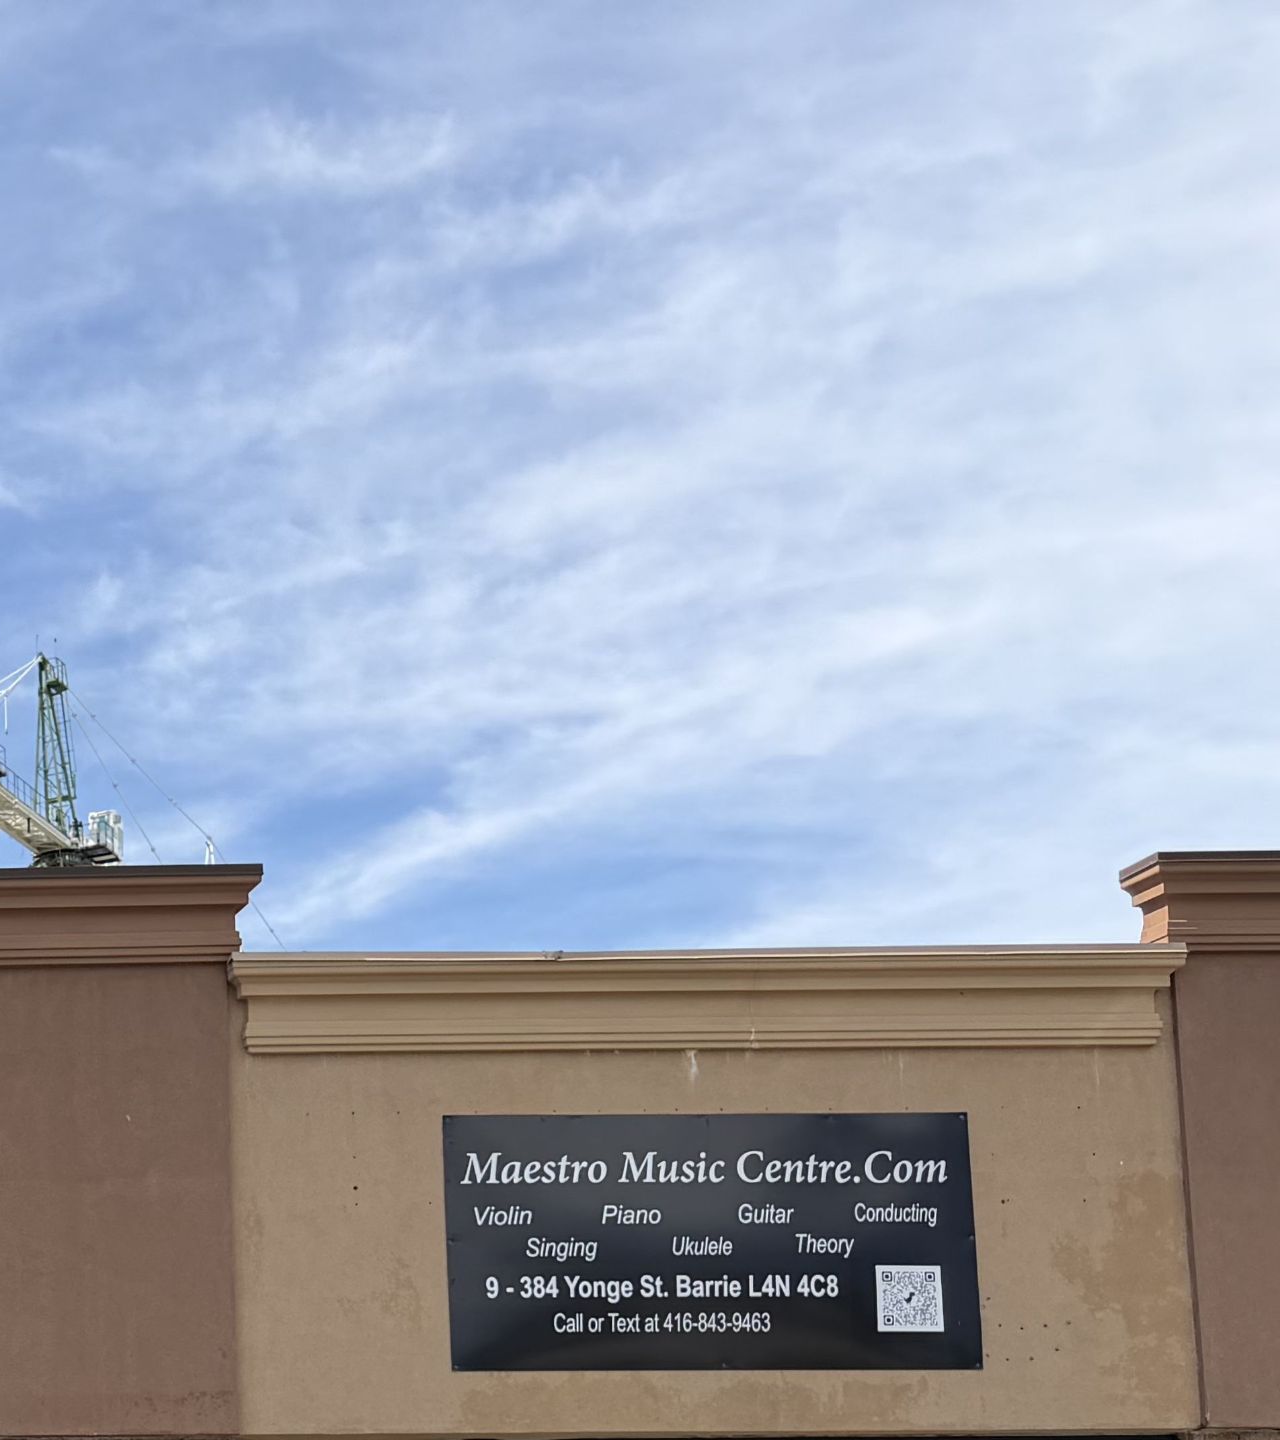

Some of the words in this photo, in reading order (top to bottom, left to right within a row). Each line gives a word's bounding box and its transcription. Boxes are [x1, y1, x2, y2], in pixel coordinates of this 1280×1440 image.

[460, 1151, 608, 1186] Maestro
[617, 1150, 725, 1185] Music
[735, 1149, 948, 1185] Centre.Com
[472, 1205, 533, 1227] Violin
[601, 1204, 662, 1226] Piano
[737, 1203, 794, 1225] Guitar
[853, 1202, 938, 1227] Conducting
[525, 1237, 598, 1262] Singing
[671, 1235, 733, 1257] Ukulele
[795, 1233, 854, 1258] Theory
[485, 1276, 499, 1299] 9
[519, 1275, 559, 1299] 384
[564, 1275, 634, 1304] Yonge
[639, 1275, 670, 1298] St.
[676, 1274, 742, 1298] Barrie
[747, 1274, 793, 1298] L4N
[796, 1274, 839, 1297] 4C8
[553, 1313, 585, 1333] Call
[587, 1318, 604, 1333] or
[607, 1313, 641, 1333] Text
[644, 1314, 660, 1333] at
[663, 1312, 771, 1333] 416-843-9463
